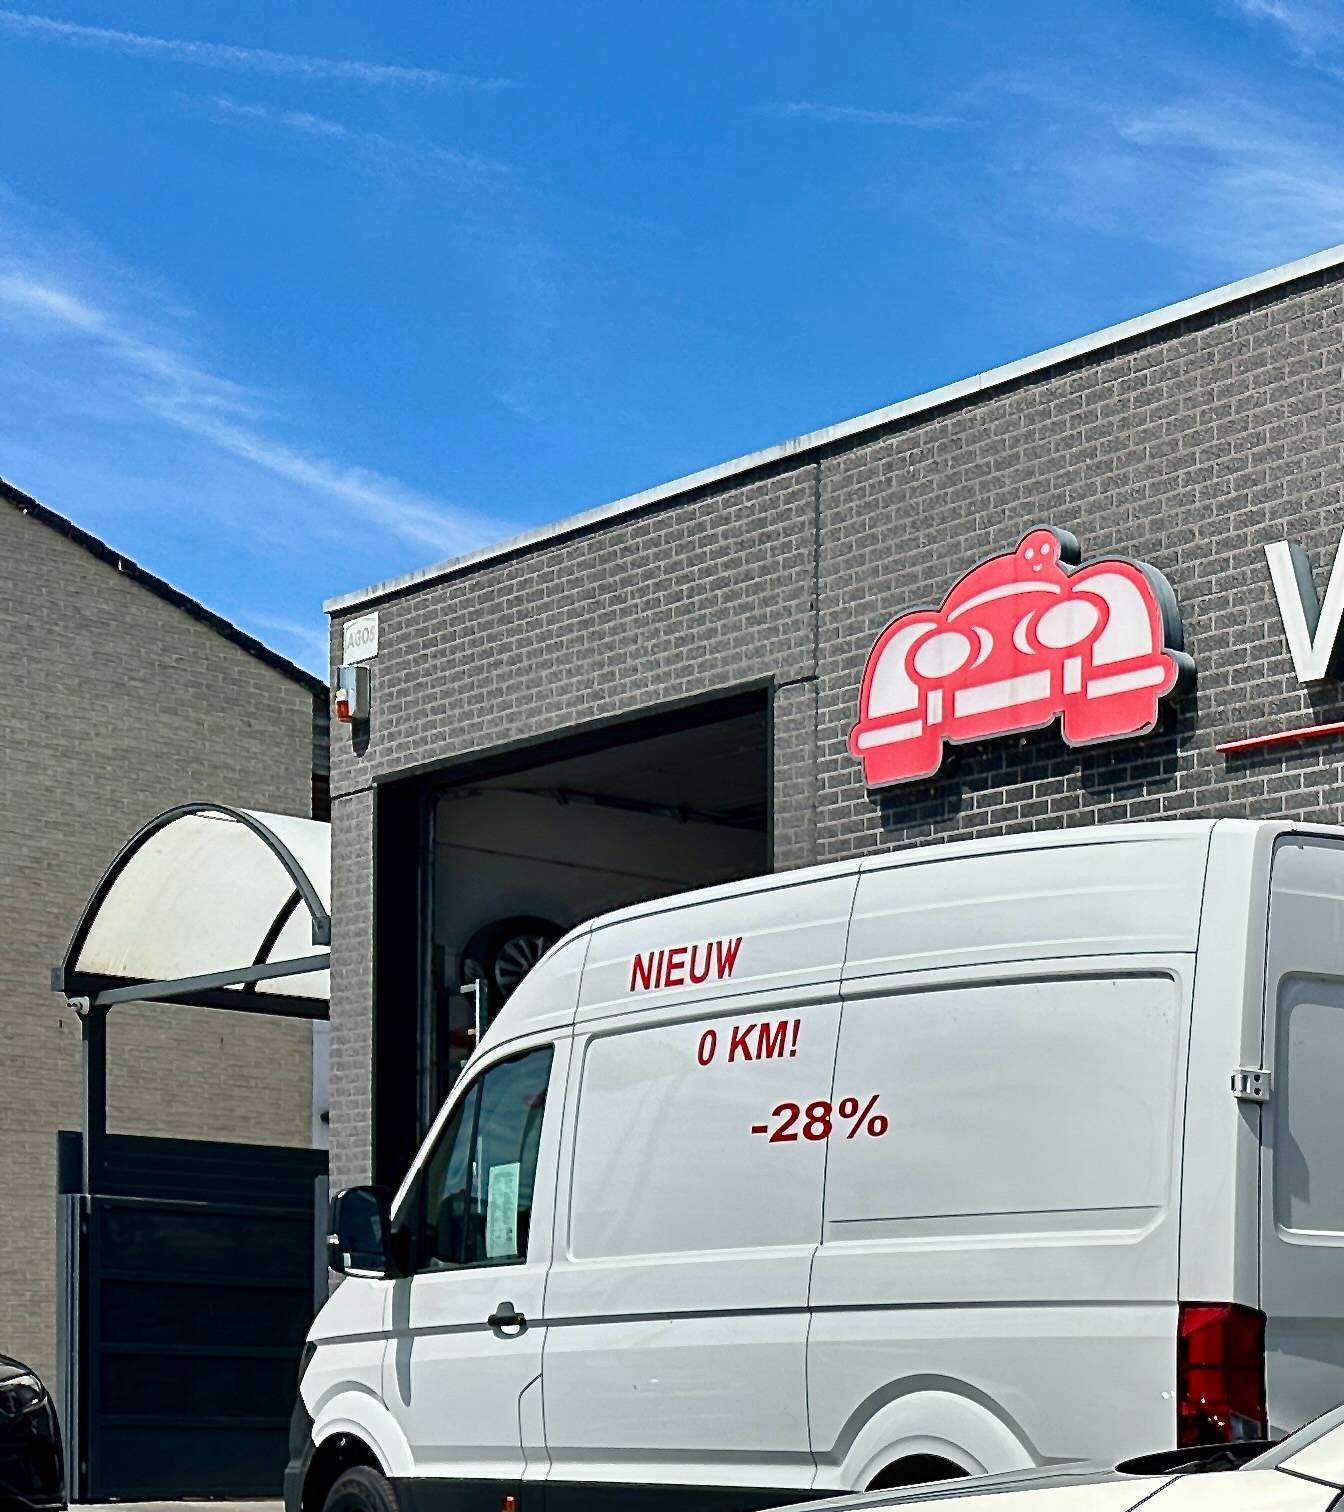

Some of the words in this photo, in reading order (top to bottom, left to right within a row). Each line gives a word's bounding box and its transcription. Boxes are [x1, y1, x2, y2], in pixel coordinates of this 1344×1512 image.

[630, 936, 743, 992] NIEUW
[697, 1029, 718, 1066] 0
[727, 1018, 801, 1063] KM!
[751, 1094, 889, 1143] -28%
